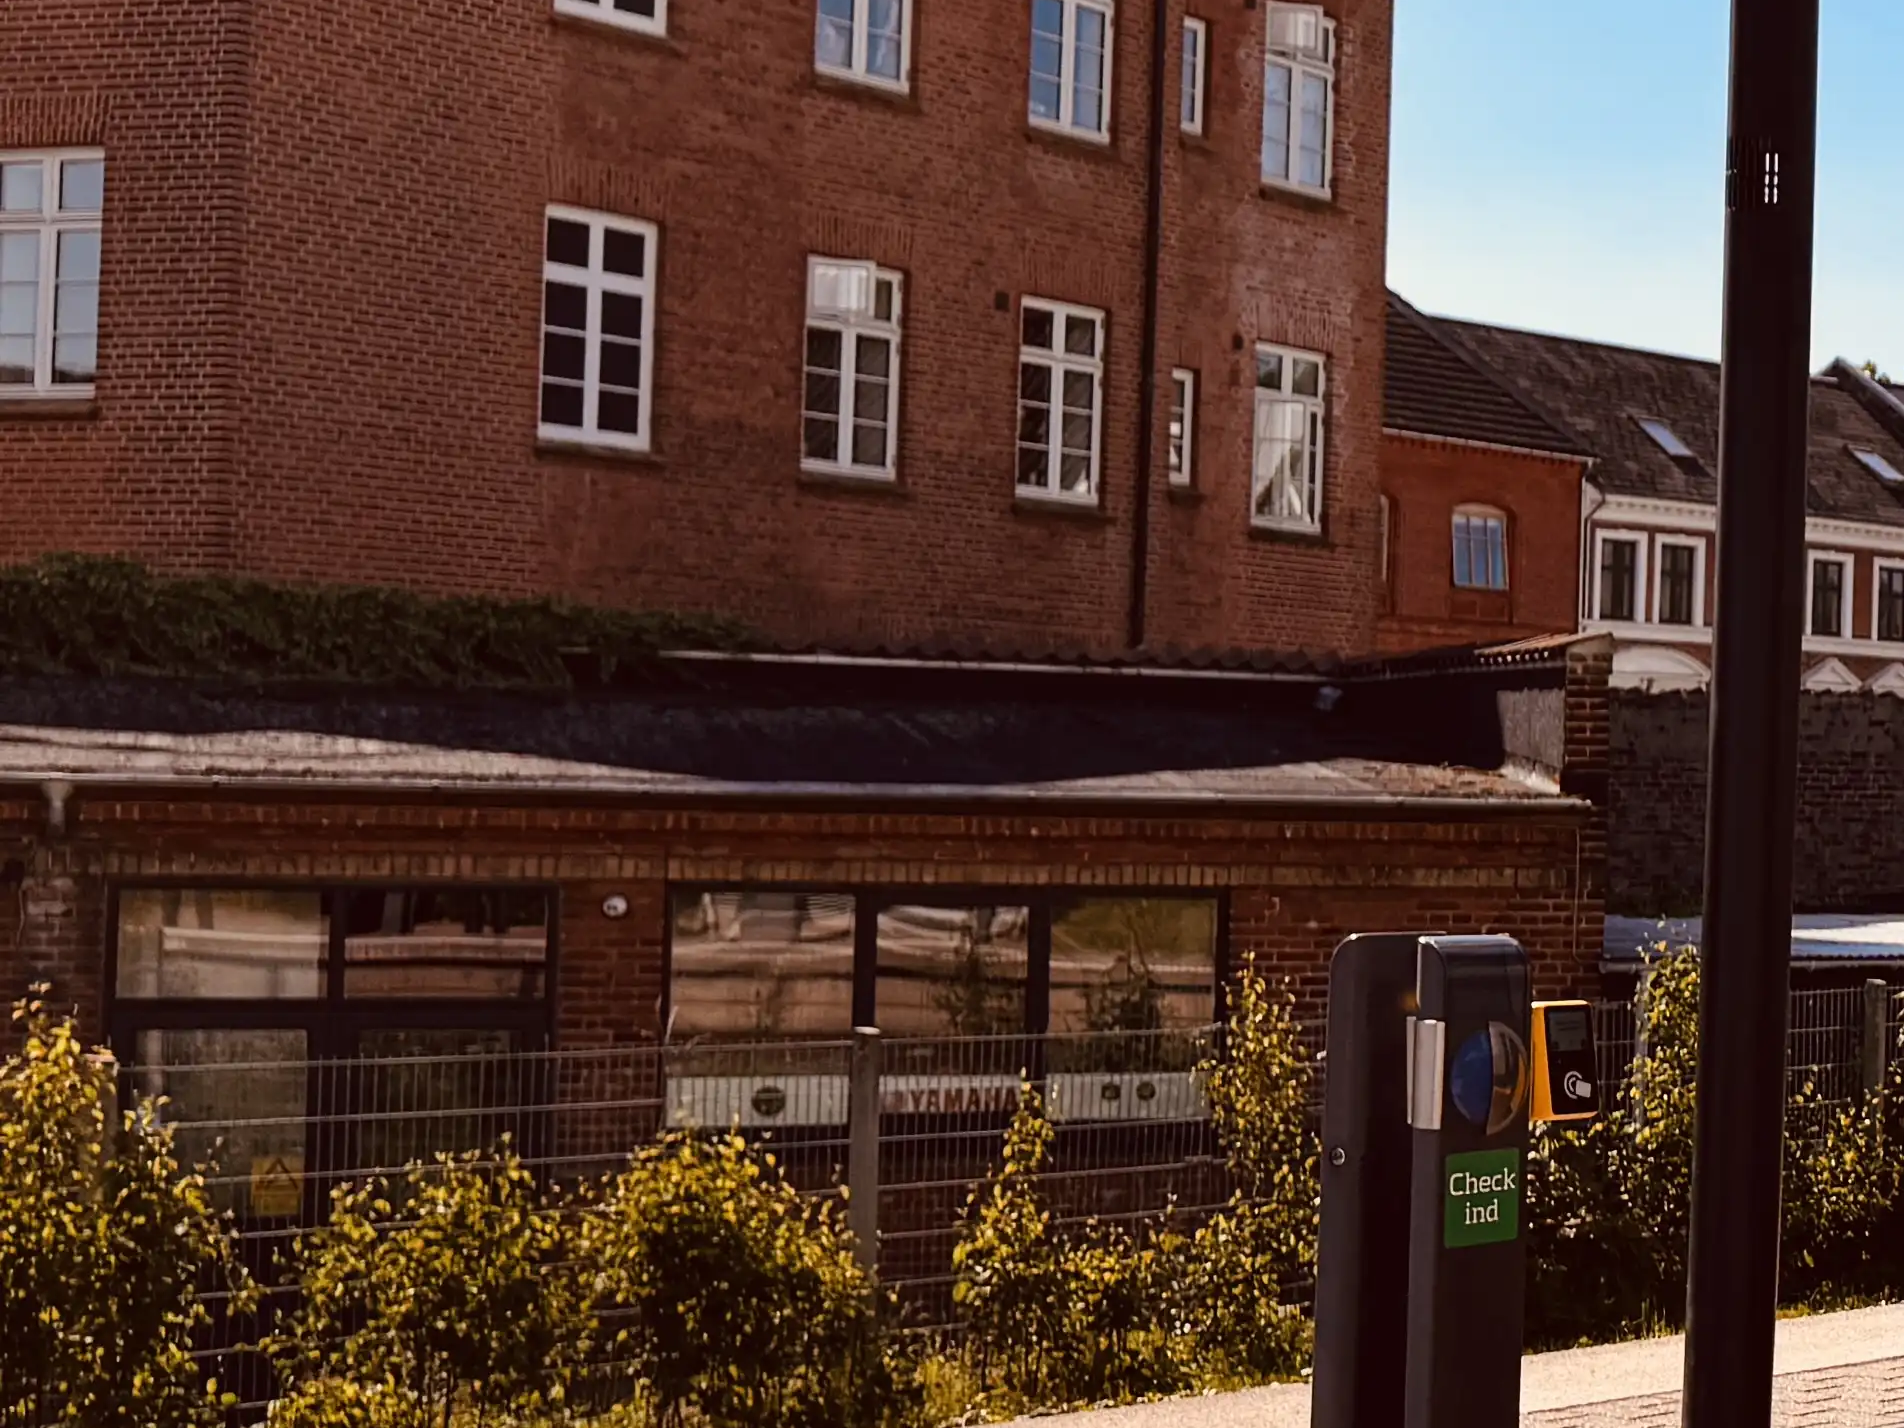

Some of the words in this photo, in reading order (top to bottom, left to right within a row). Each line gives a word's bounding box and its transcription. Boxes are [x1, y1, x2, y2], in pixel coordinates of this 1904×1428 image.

[909, 1087, 1020, 1114] YAMAHA
[1449, 1166, 1517, 1197] Check
[1464, 1197, 1499, 1225] ind
